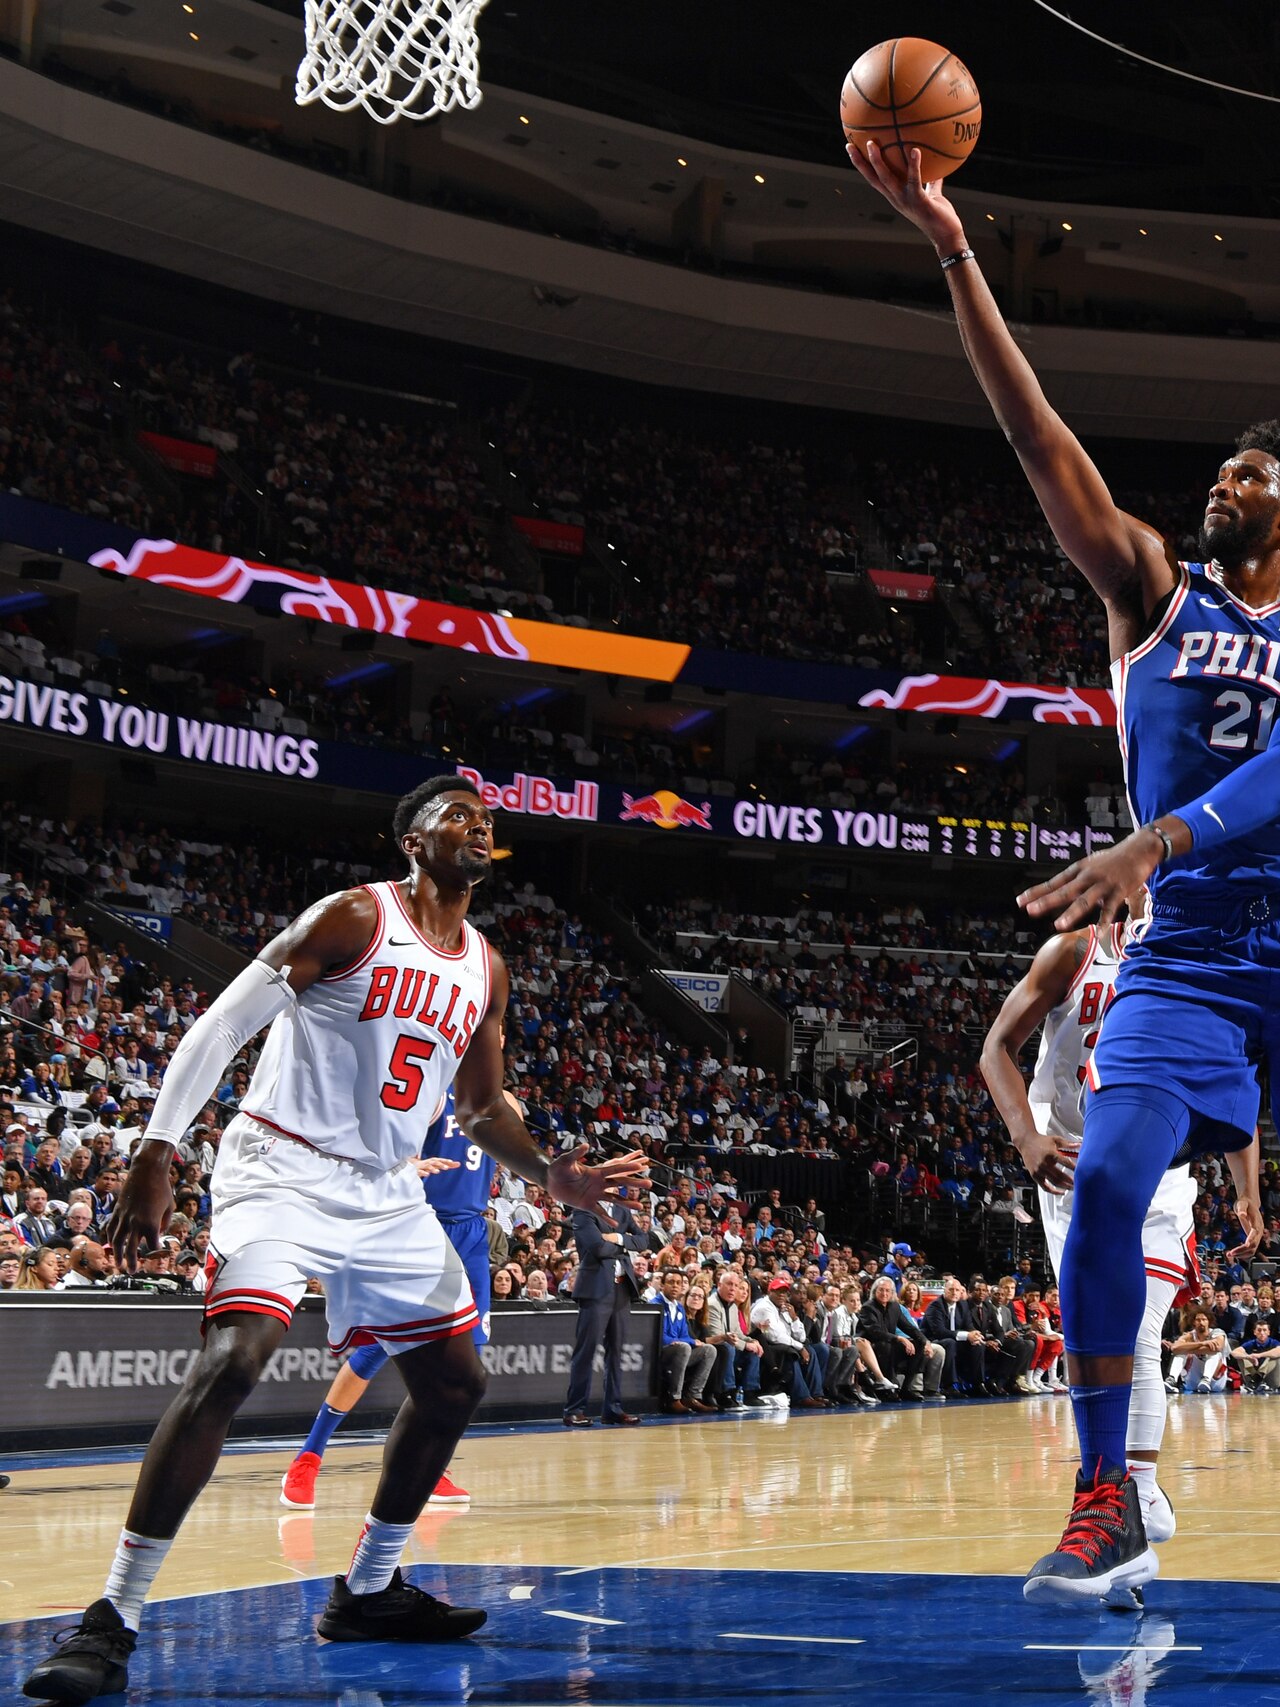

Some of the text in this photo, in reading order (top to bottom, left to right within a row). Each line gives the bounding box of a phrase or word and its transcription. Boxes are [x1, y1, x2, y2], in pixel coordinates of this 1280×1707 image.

[0, 675, 320, 779] GIVES YOU WIIINGS
[1209, 690, 1278, 751] 21
[733, 801, 898, 849] GIVES YOU
[966, 828, 977, 841] 2
[990, 829, 1002, 843] 2
[1014, 831, 1026, 845] 2
[1038, 829, 1081, 848] 8:24
[941, 840, 953, 854] 2
[965, 841, 977, 856] 4
[358, 966, 478, 1059] BULLS
[380, 1034, 437, 1112] 5
[465, 1144, 483, 1171] 9
[46, 1349, 201, 1390] AMERIC
[479, 1344, 548, 1375] RICAN
